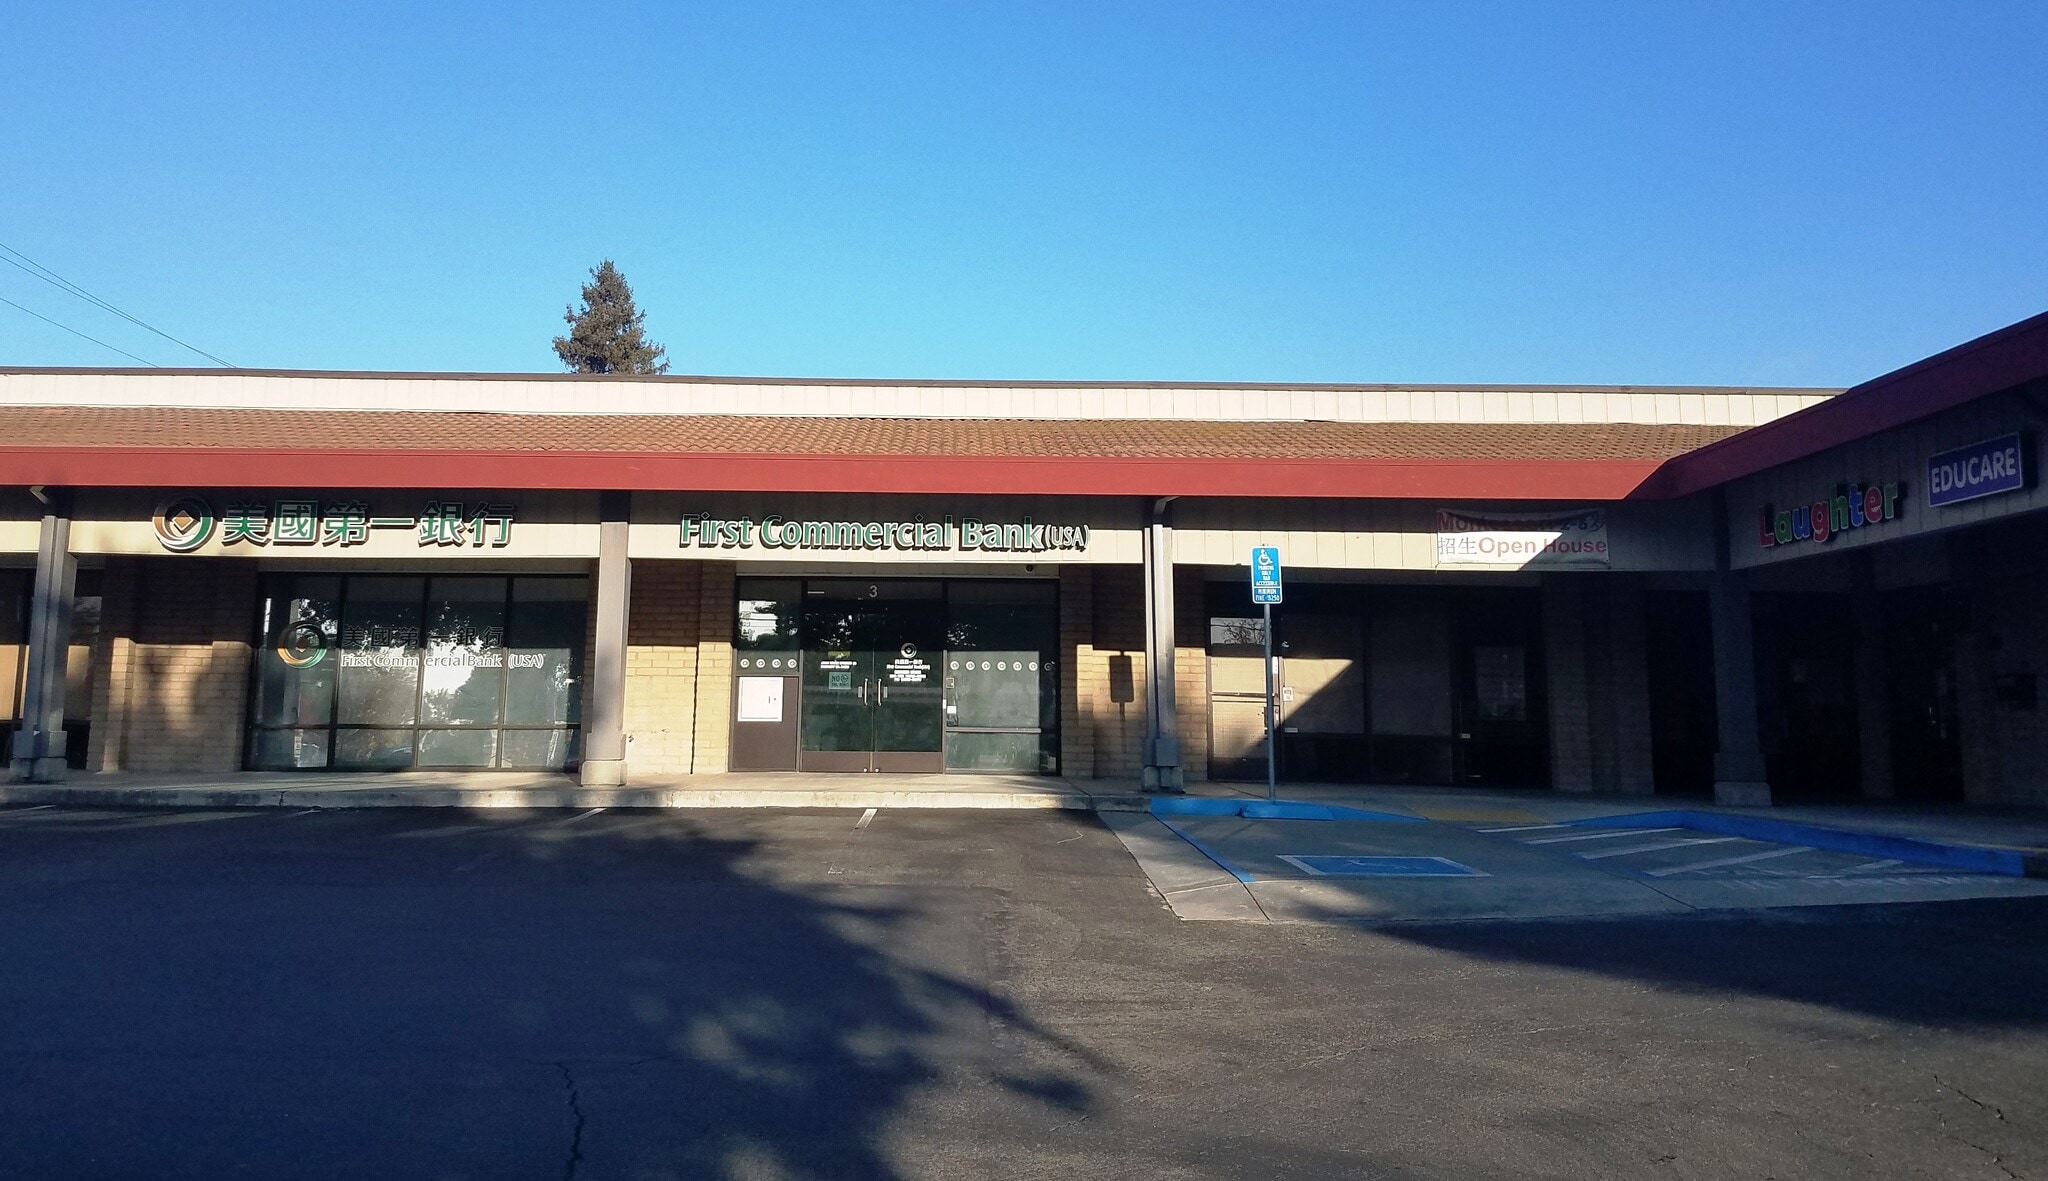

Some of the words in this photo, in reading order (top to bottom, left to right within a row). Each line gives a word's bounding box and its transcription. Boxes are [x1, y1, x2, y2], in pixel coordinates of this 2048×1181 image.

[1931, 447, 2016, 494] EDUCARE
[222, 500, 514, 546] 美國第一銀行
[1759, 483, 1898, 547] Laughter
[680, 511, 753, 546] First
[760, 513, 952, 548] Commercial
[962, 515, 1045, 549] Bank
[1045, 524, 1090, 548] (USA)
[1438, 537, 1477, 555] 招生
[1479, 537, 1536, 557] Open
[1544, 538, 1607, 554] House
[869, 585, 878, 598] 3
[343, 626, 504, 647] 美國第一銀行
[341, 654, 374, 668] First
[508, 653, 545, 670] (USA)
